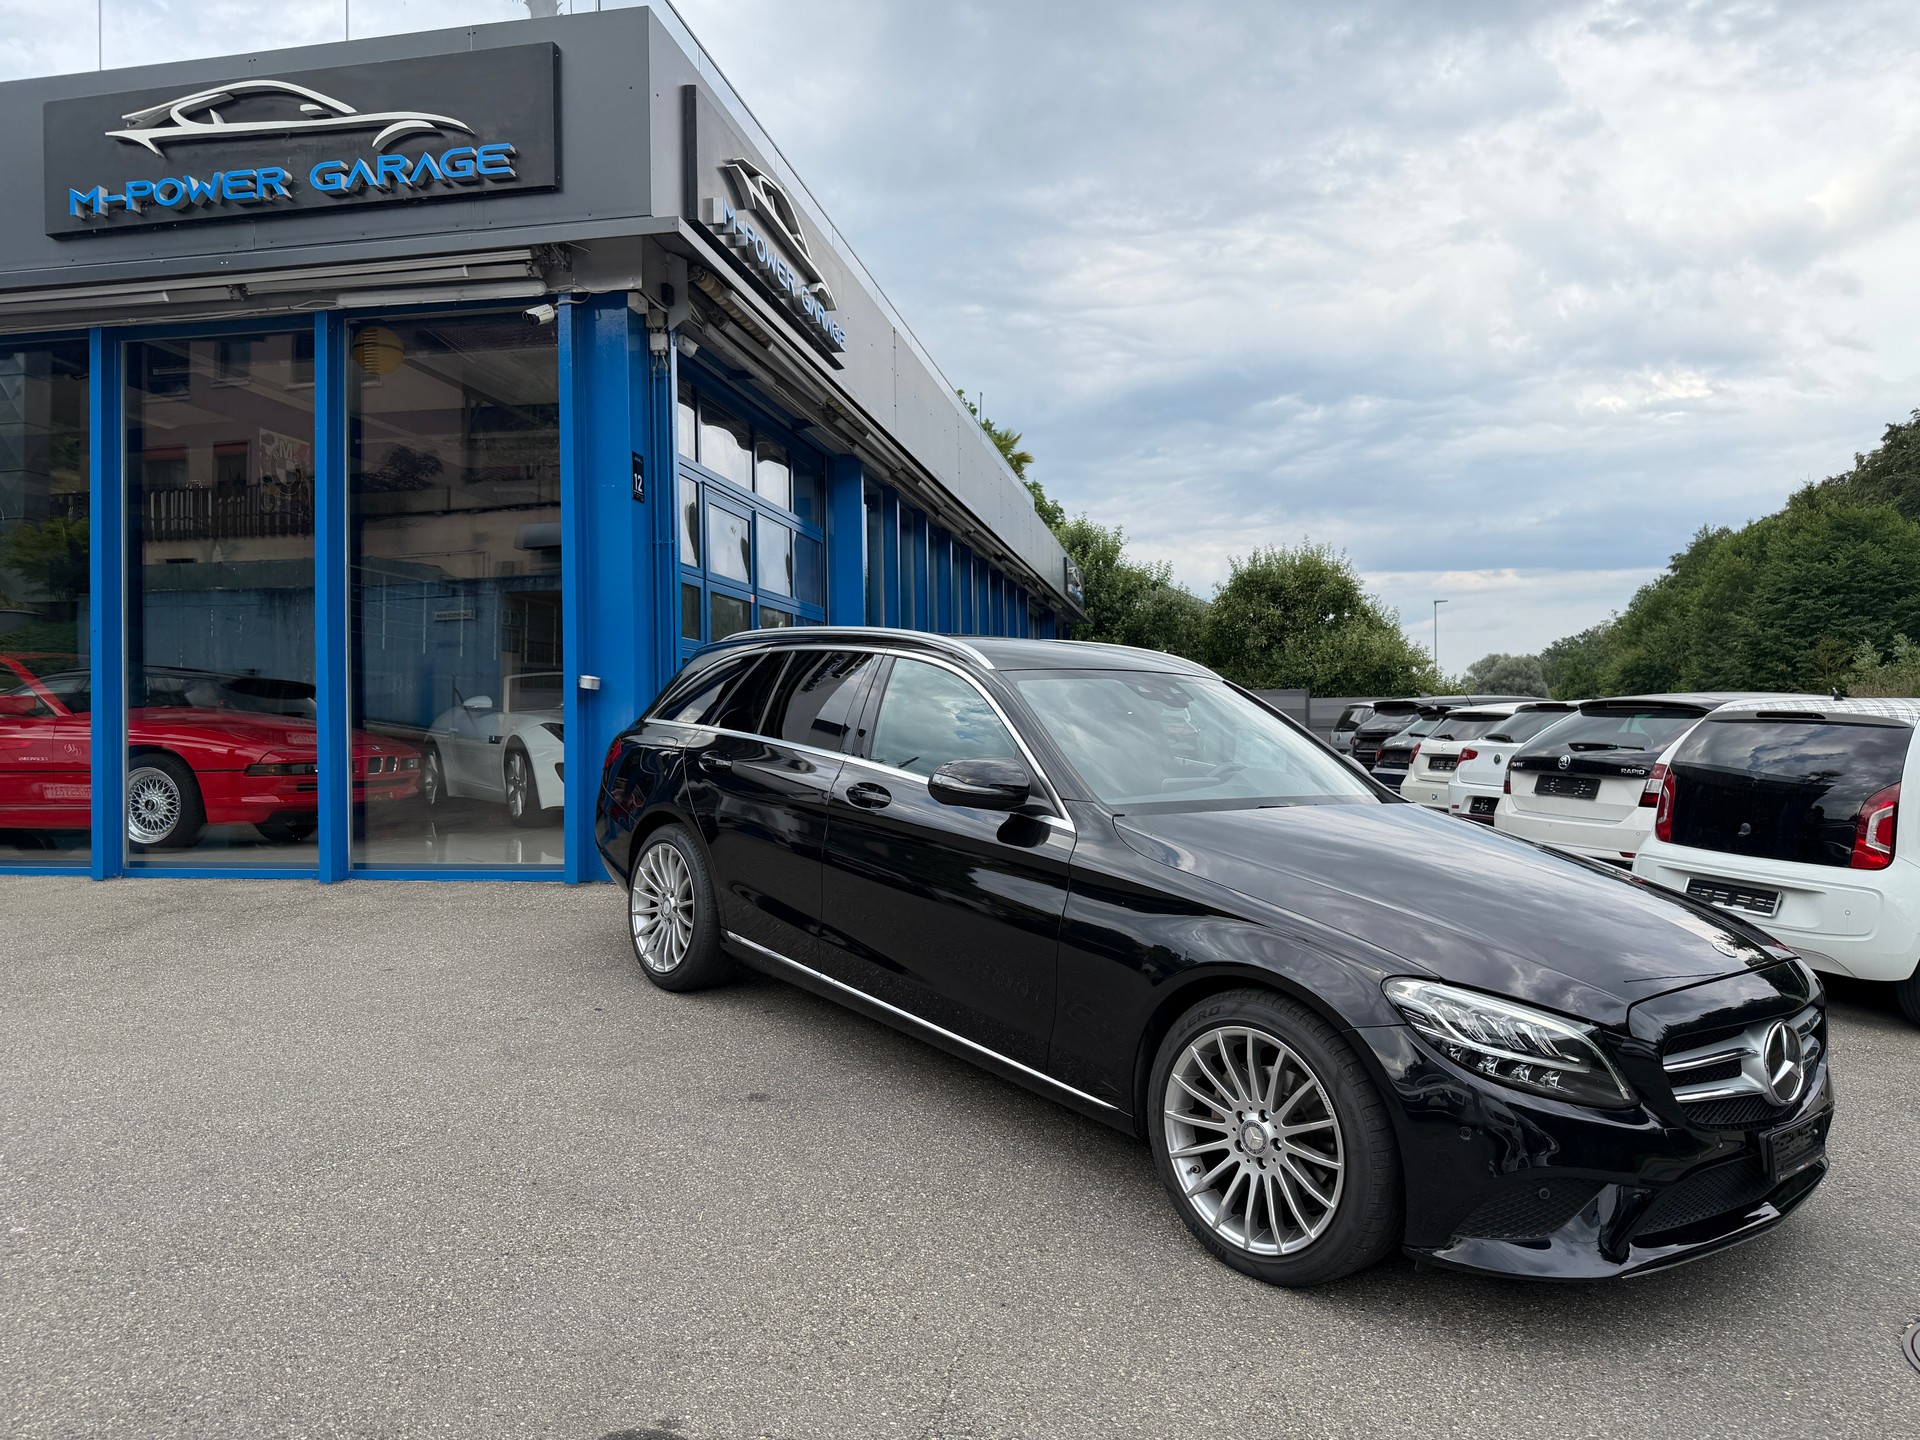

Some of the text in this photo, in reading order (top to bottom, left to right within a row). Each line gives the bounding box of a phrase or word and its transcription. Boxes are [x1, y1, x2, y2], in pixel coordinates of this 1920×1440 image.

[69, 143, 517, 217] M-POWER GARAGE
[722, 197, 847, 353] M-POWER GARAGE
[634, 473, 643, 493] 12
